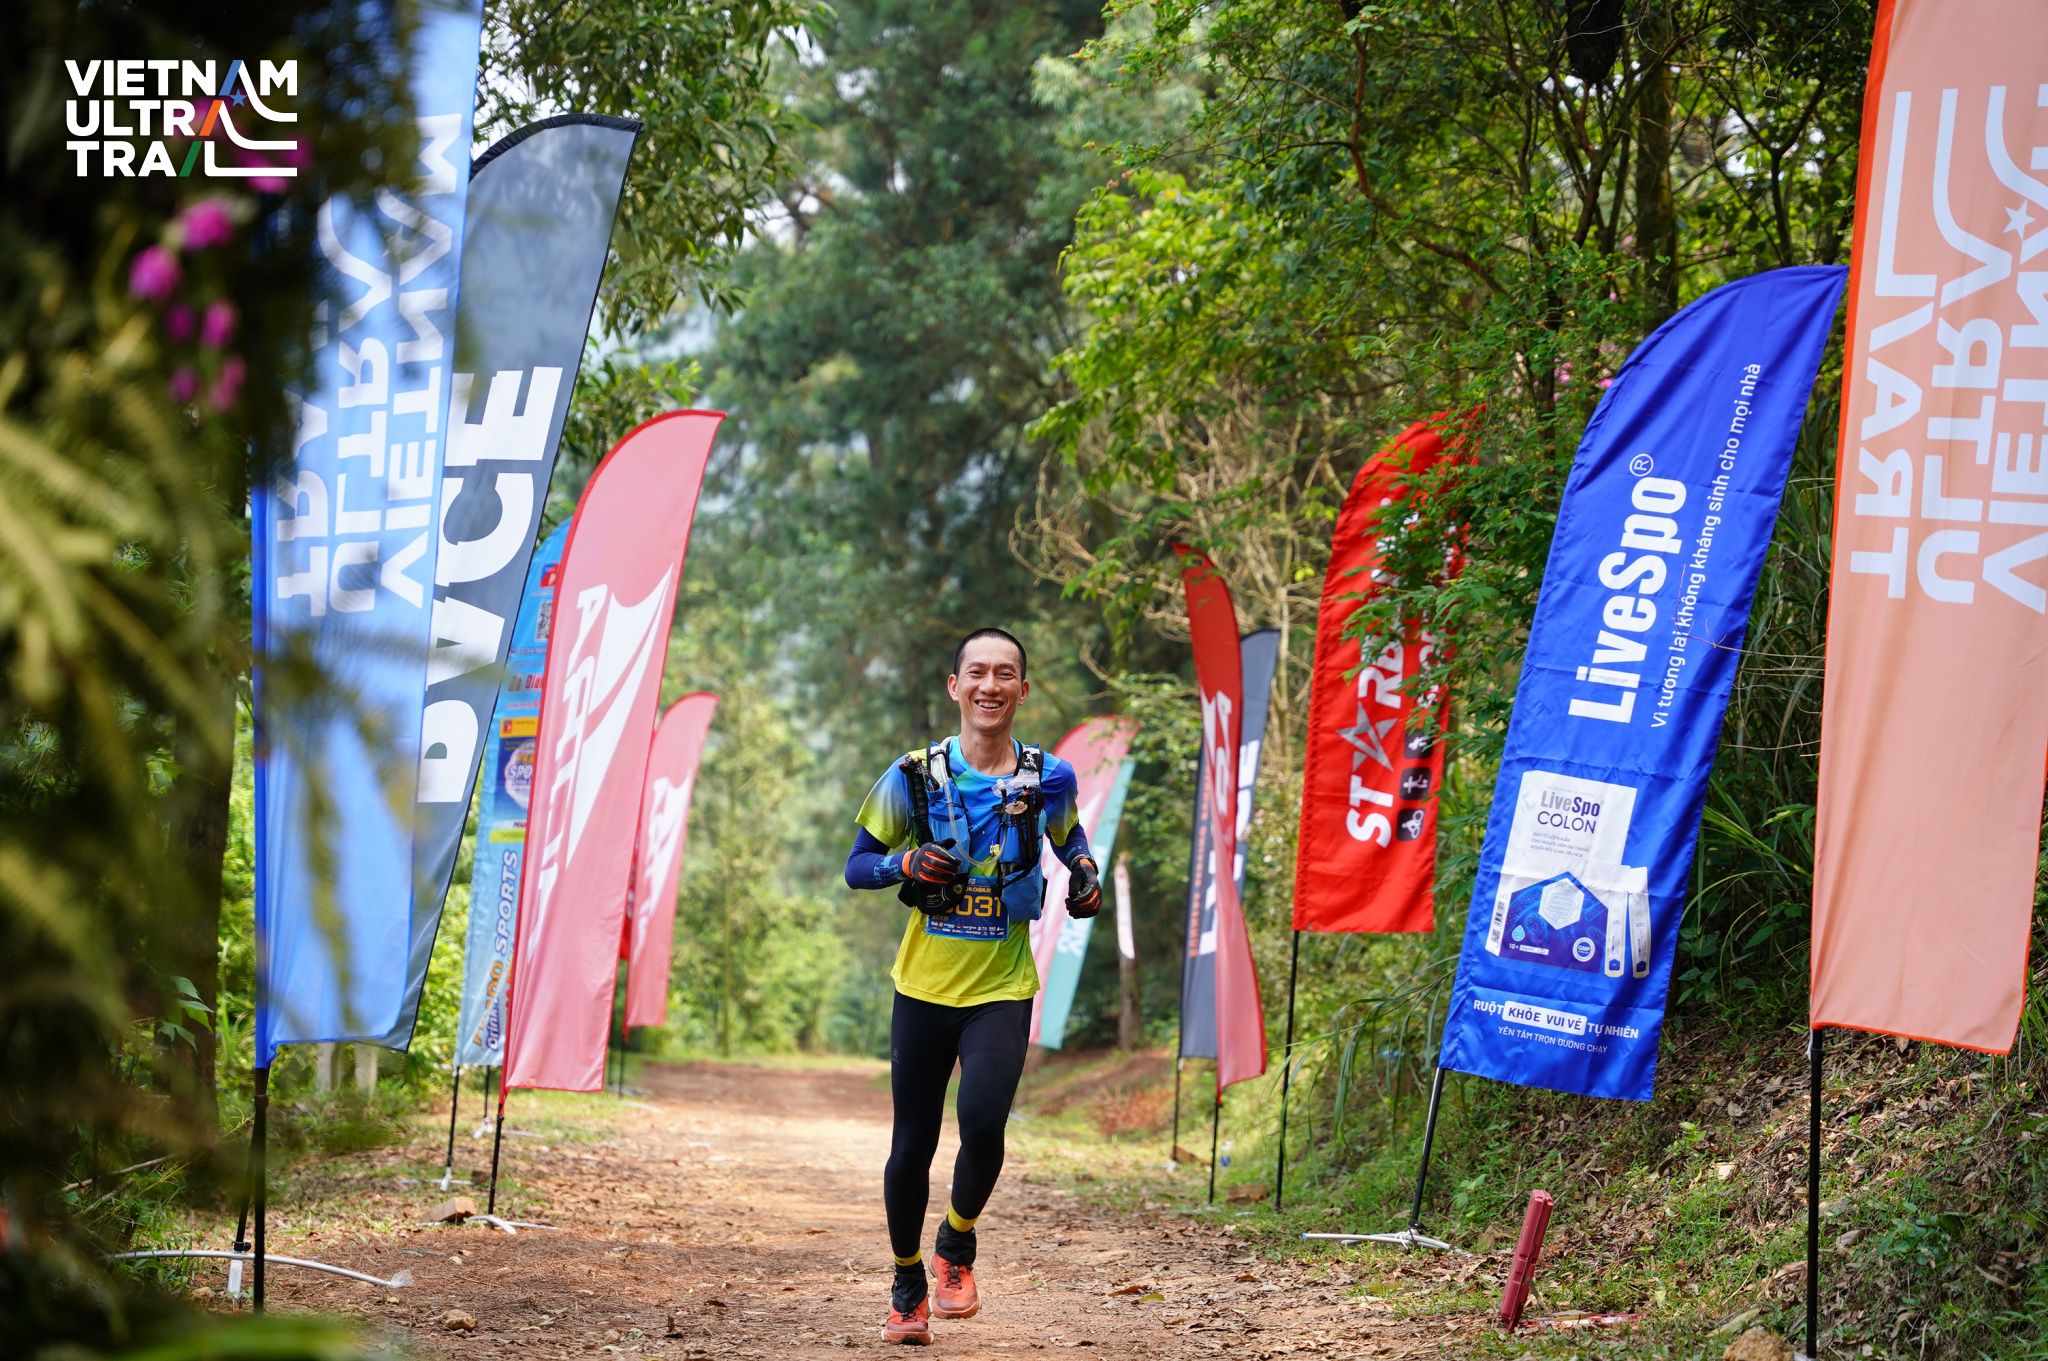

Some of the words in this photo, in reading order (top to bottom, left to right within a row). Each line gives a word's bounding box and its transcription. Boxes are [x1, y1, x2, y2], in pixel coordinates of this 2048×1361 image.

[1737, 362, 1762, 397] nhà
[1731, 399, 1754, 434] mọi
[1718, 436, 1741, 471] cho
[1707, 474, 1730, 512] sinh
[1692, 513, 1722, 569] kháng
[1674, 571, 1707, 627] không
[1669, 630, 1688, 652] lai
[1657, 656, 1685, 707] tương
[1652, 711, 1668, 727] Vì
[1537, 811, 1593, 833] COLON
[495, 850, 517, 953] SPORTS
[948, 894, 1002, 918] 031
[1473, 999, 1503, 1017] RUỘT
[1508, 1006, 1542, 1022] KHỎE
[1546, 1015, 1565, 1027] VUI
[1567, 1018, 1582, 1031] VẺ
[1587, 1023, 1603, 1038] TỰ
[1605, 1025, 1639, 1039] NHIÊN
[1498, 1025, 1515, 1036] YÊN
[1516, 1029, 1533, 1040] TÂM
[1534, 1033, 1556, 1045] TRỌN
[1586, 1043, 1608, 1055] CHẠY
